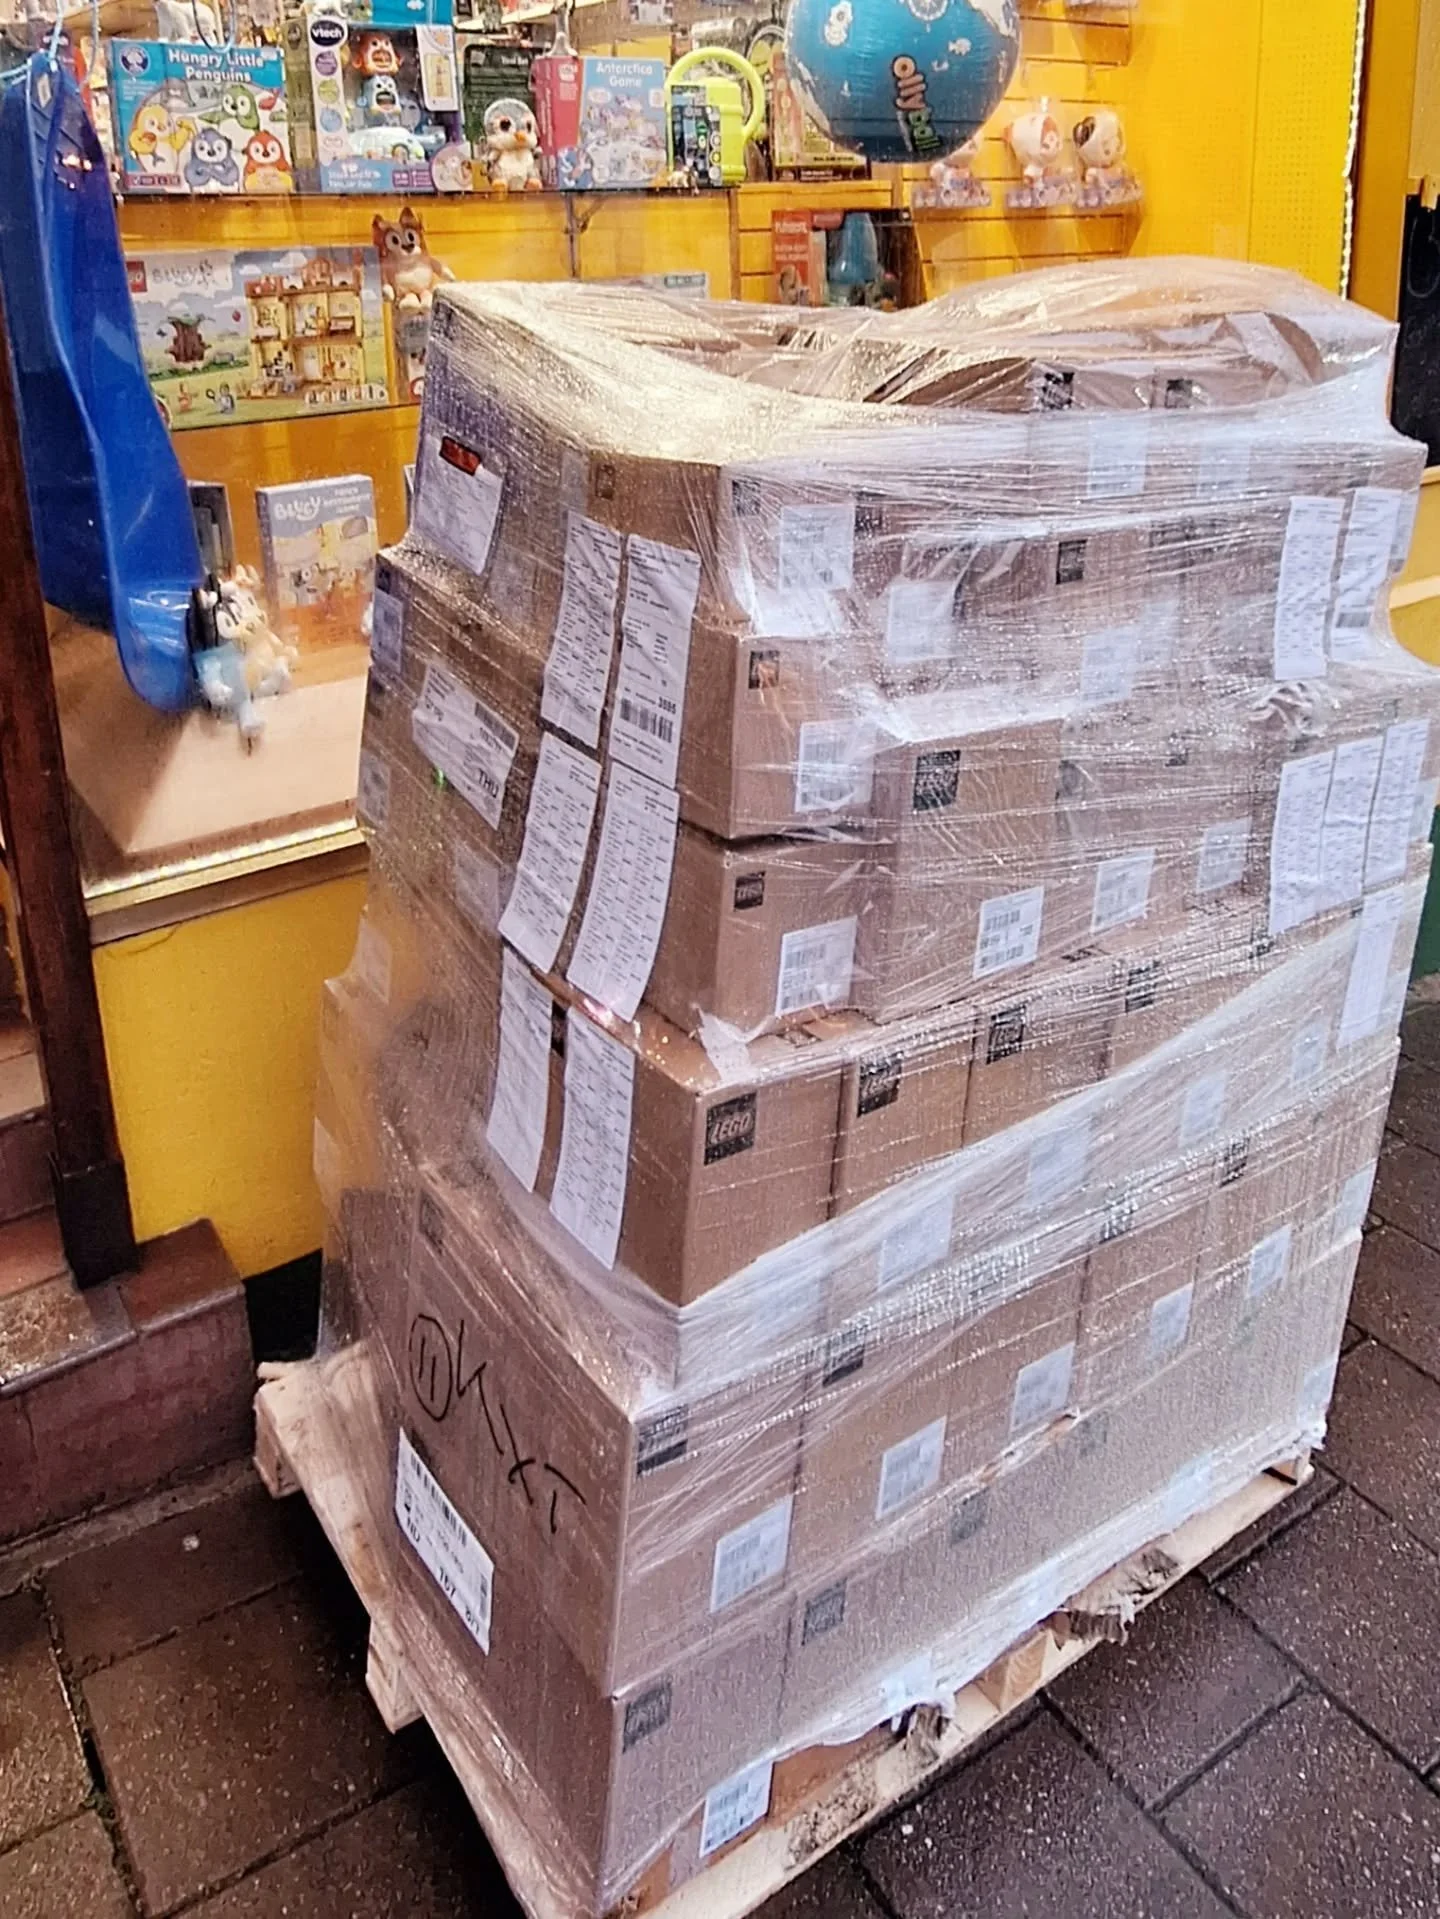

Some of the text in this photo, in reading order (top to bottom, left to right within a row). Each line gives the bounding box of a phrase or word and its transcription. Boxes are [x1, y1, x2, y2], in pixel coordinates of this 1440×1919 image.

[311, 27, 342, 38] vtech
[168, 49, 264, 67] Hungry Little
[185, 67, 251, 83] Penguins
[596, 61, 653, 75] Antarctica
[609, 75, 642, 88] Game
[274, 496, 321, 521] Bluey
[478, 767, 499, 798] THU
[710, 1111, 752, 1145] LEGO
